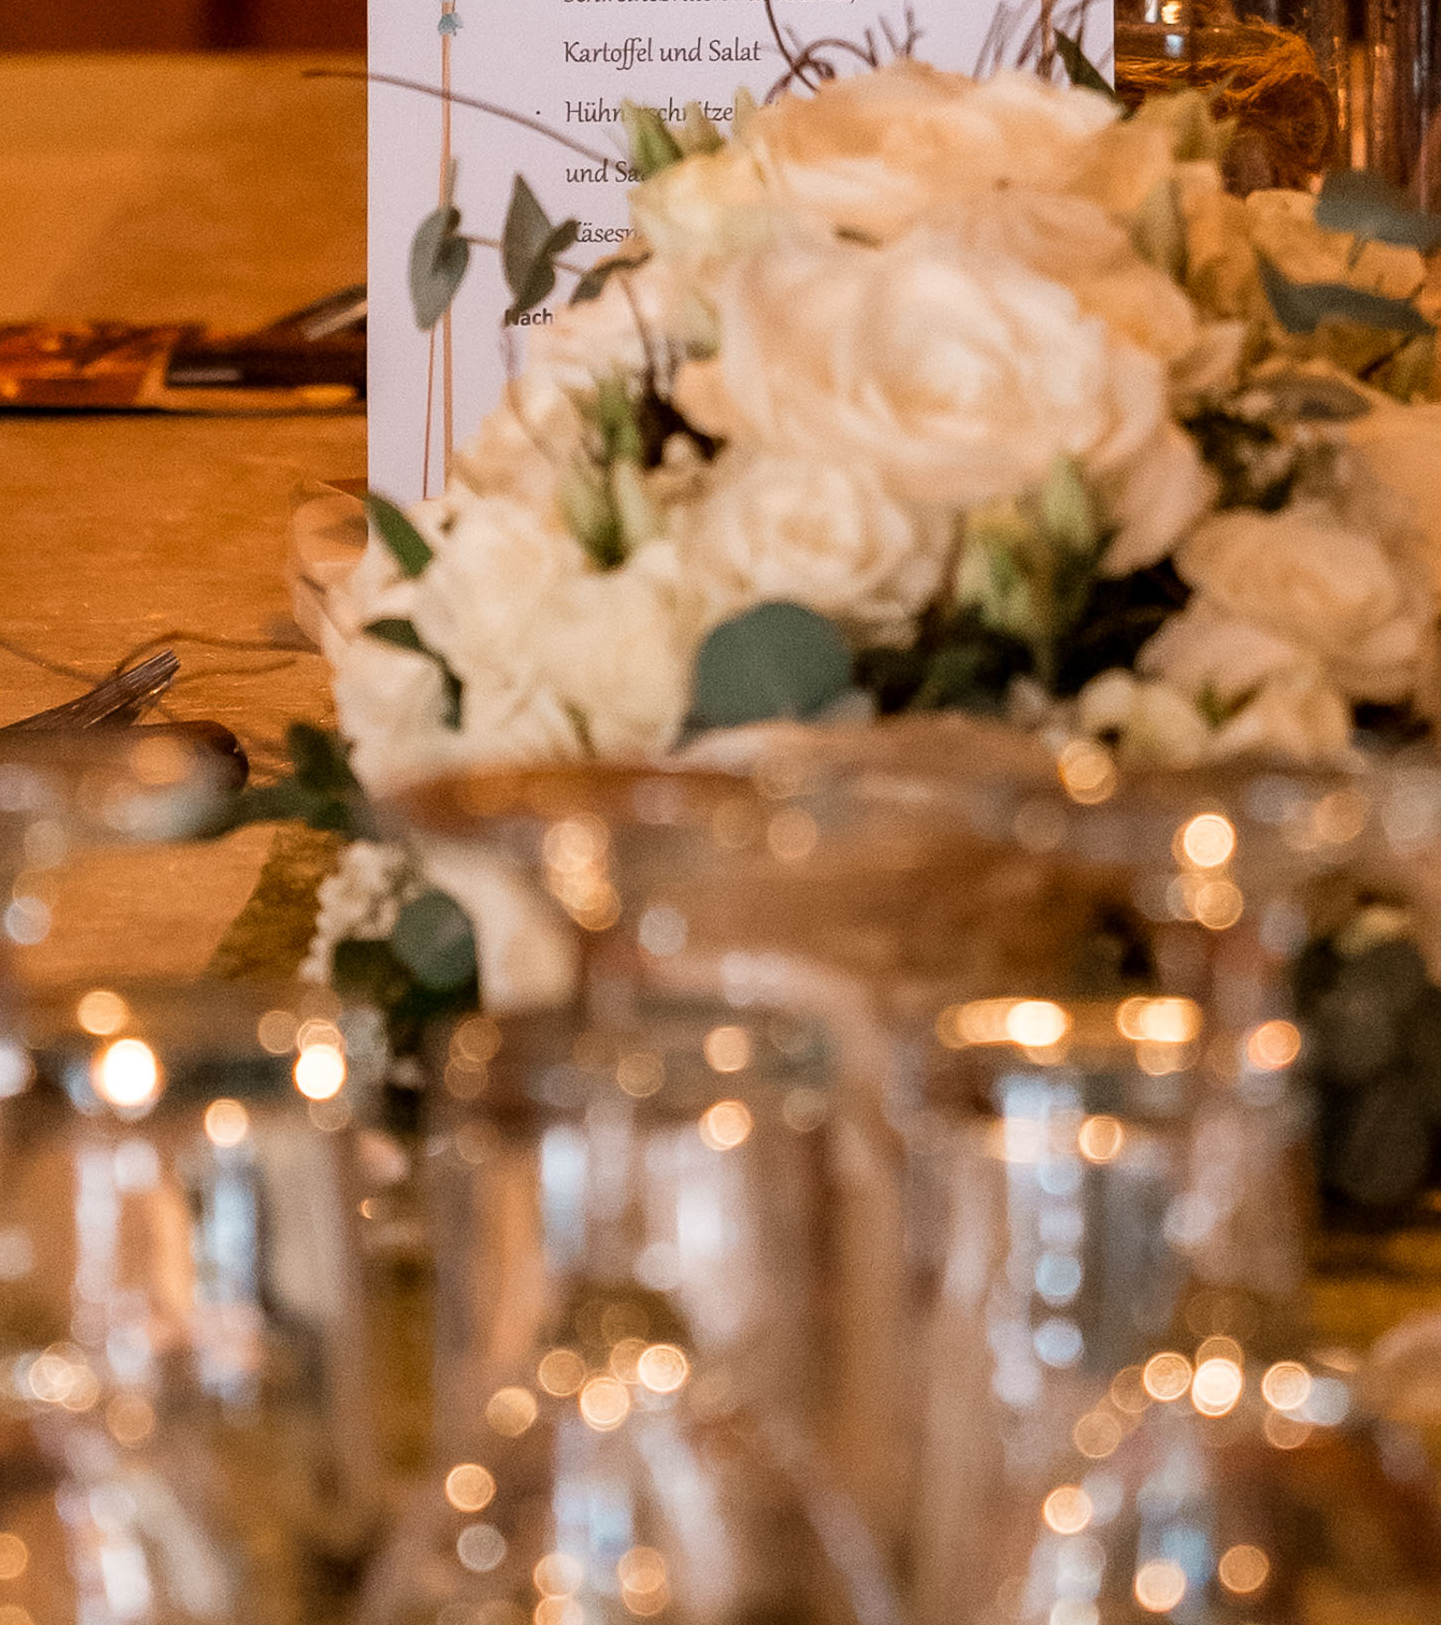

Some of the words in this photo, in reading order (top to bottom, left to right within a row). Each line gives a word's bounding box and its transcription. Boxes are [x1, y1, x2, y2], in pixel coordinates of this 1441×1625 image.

[562, 37, 654, 71] Kartoffel
[659, 37, 703, 62] und
[708, 37, 762, 62] Salat
[565, 158, 610, 183] und
